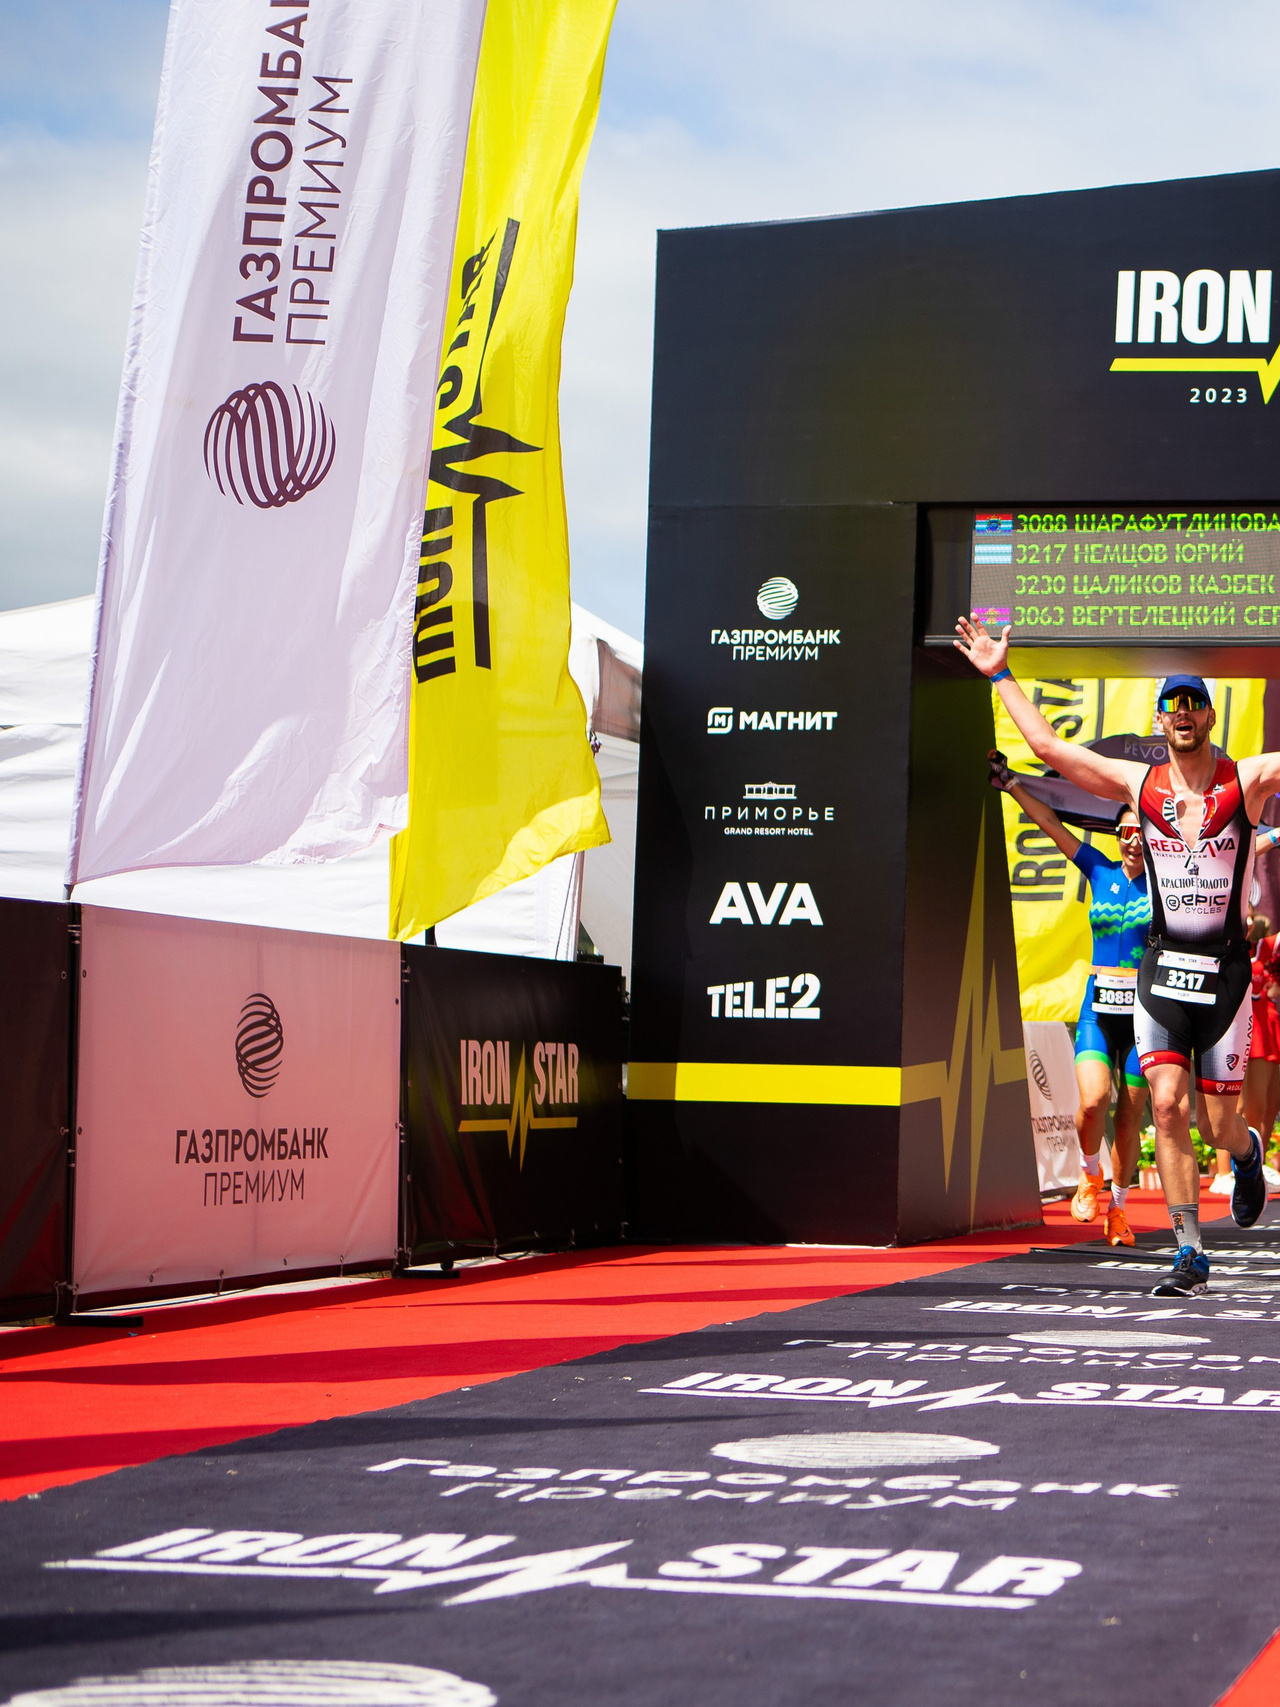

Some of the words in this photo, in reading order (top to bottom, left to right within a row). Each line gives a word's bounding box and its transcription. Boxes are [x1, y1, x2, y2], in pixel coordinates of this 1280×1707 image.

[232, 0, 310, 343] ГАЗПРОМБА
[285, 75, 353, 345] ПРЕМИУМ
[1115, 269, 1273, 343] IRON
[1189, 388, 1248, 403] 2023
[1016, 514, 1067, 534] 3088
[1015, 544, 1067, 564] 3217
[1073, 543, 1168, 567] НЕМЦОВ
[1175, 539, 1244, 564] ЮРИЙ
[1015, 574, 1066, 595] 3230
[1072, 574, 1182, 599] ЦАЛИКОВ
[1189, 574, 1276, 595] КАЗБЕК
[1014, 605, 1065, 626] 3063
[1072, 602, 1236, 630] ВЕРТЕЛЕЦКИЙ
[711, 629, 841, 645] ГАЗПРОМБАНК
[732, 646, 819, 661] ПРЕМИУМ
[739, 711, 838, 730] МАГНИТ
[704, 806, 835, 821] ПРИМОРЬЕ
[724, 828, 753, 836] GRAND
[754, 828, 786, 836] RESORT
[787, 828, 814, 836] HOTEL
[1161, 877, 1196, 889] КРАСНОЕ
[709, 882, 823, 926] AVA
[1185, 907, 1222, 915] CYCLES
[1166, 970, 1205, 990] 3217
[707, 973, 821, 1019] TELE2
[1099, 988, 1134, 1005] 3088
[460, 1040, 511, 1106] IRON
[532, 1041, 579, 1105] STAR
[175, 1127, 329, 1164] ГАЗПРОМБАНК
[203, 1168, 305, 1207] ПРЕМИУМ
[935, 1300, 1128, 1314] IRON
[662, 1372, 928, 1398] IRON
[95, 1528, 516, 1568] IRON
[658, 1543, 1083, 1596] STAR
